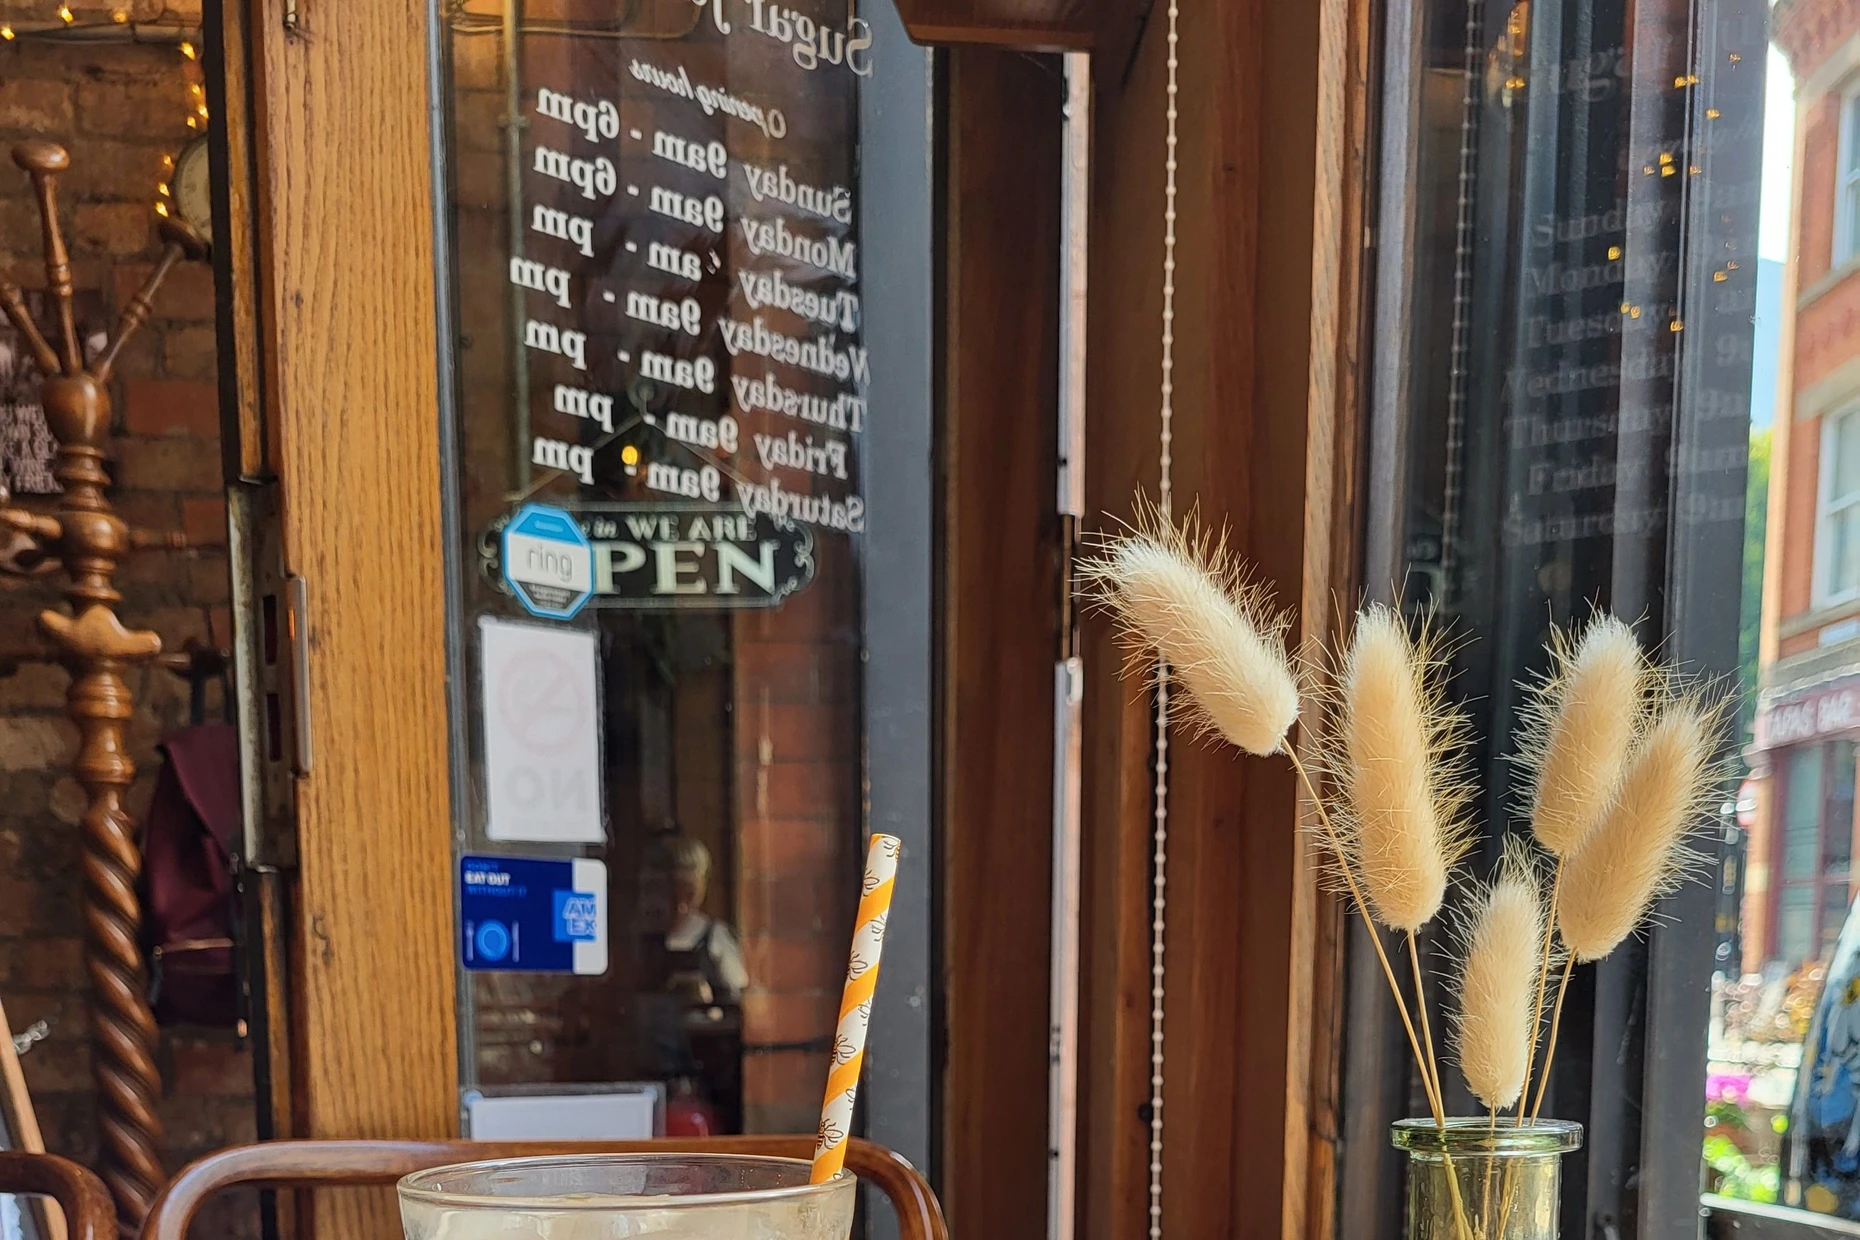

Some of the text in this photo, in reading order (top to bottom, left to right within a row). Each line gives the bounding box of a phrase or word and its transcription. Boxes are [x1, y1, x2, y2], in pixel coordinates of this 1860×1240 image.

[625, 514, 680, 541] WE
[688, 516, 757, 541] ARE
[527, 544, 573, 583] ring
[592, 540, 780, 596] PEN
